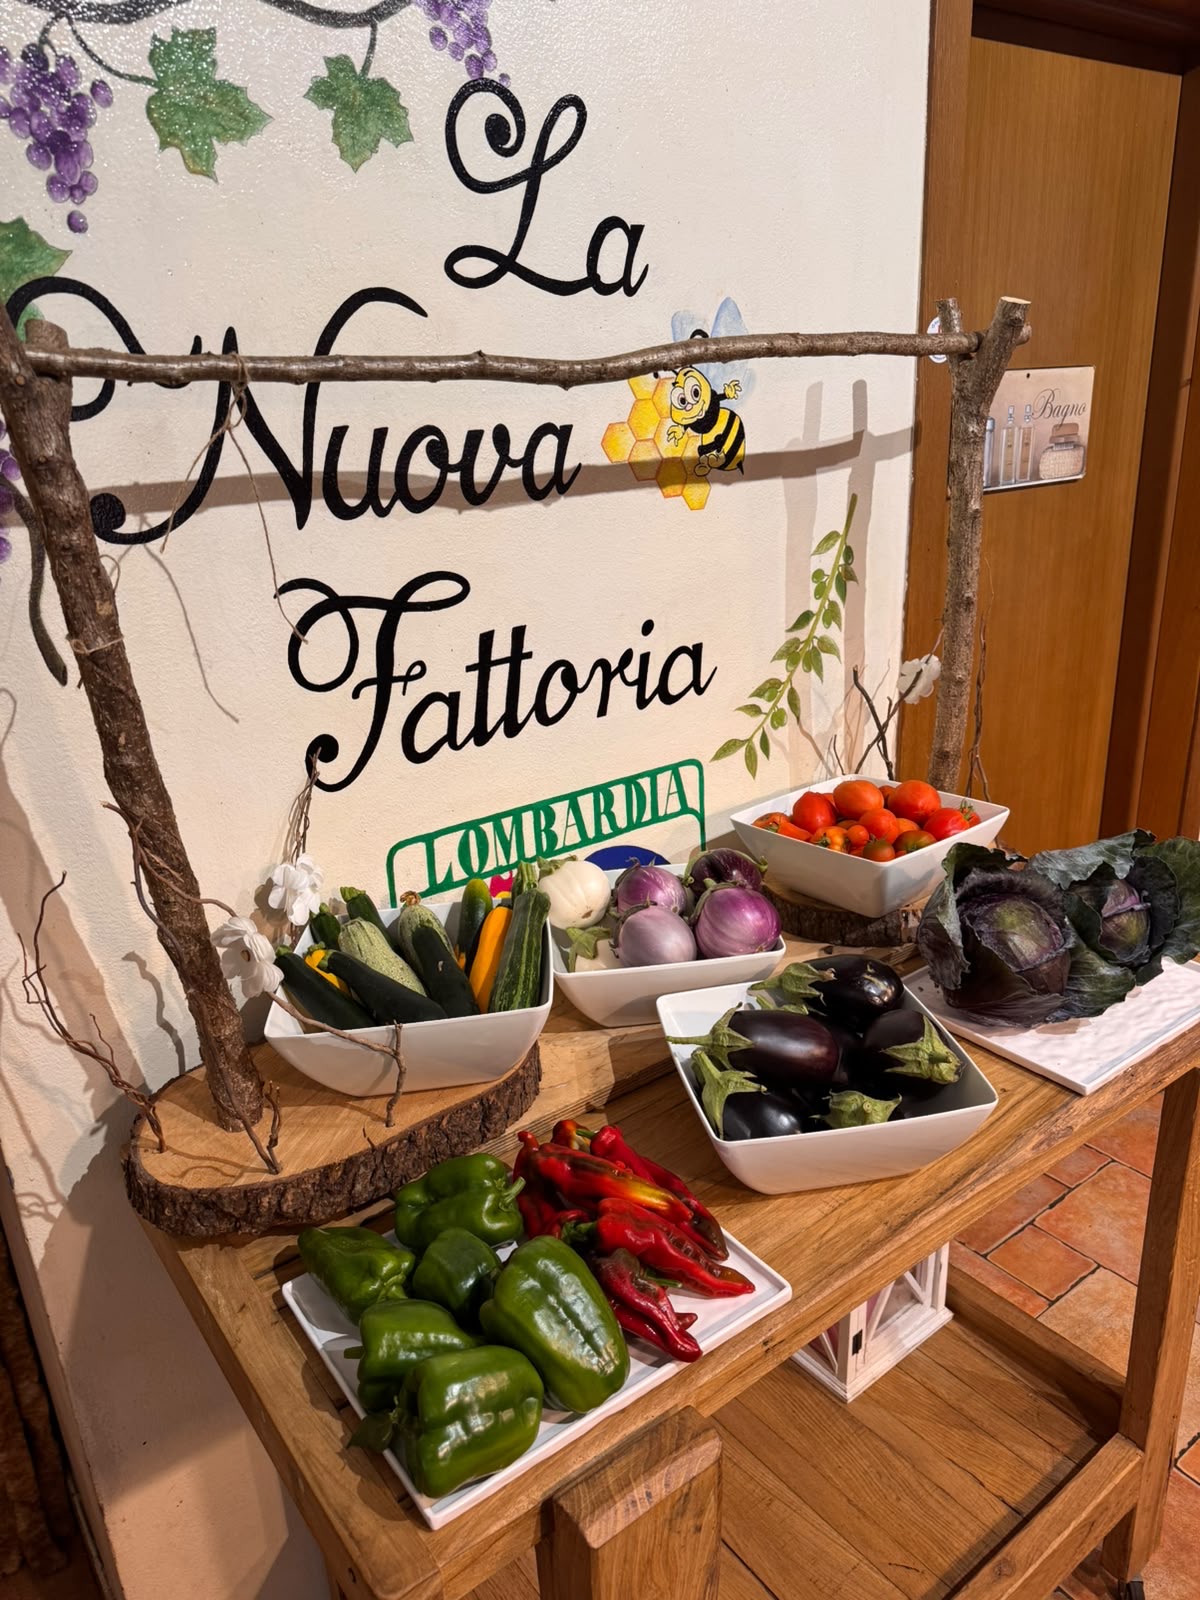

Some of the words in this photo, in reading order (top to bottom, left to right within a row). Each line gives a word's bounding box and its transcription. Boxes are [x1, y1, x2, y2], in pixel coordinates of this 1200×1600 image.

[445, 77, 649, 297] La
[9, 276, 582, 545] Nuova
[1031, 388, 1087, 429] Bagno
[273, 570, 718, 793] Fattoria
[423, 764, 690, 891] LOMBARDIA
